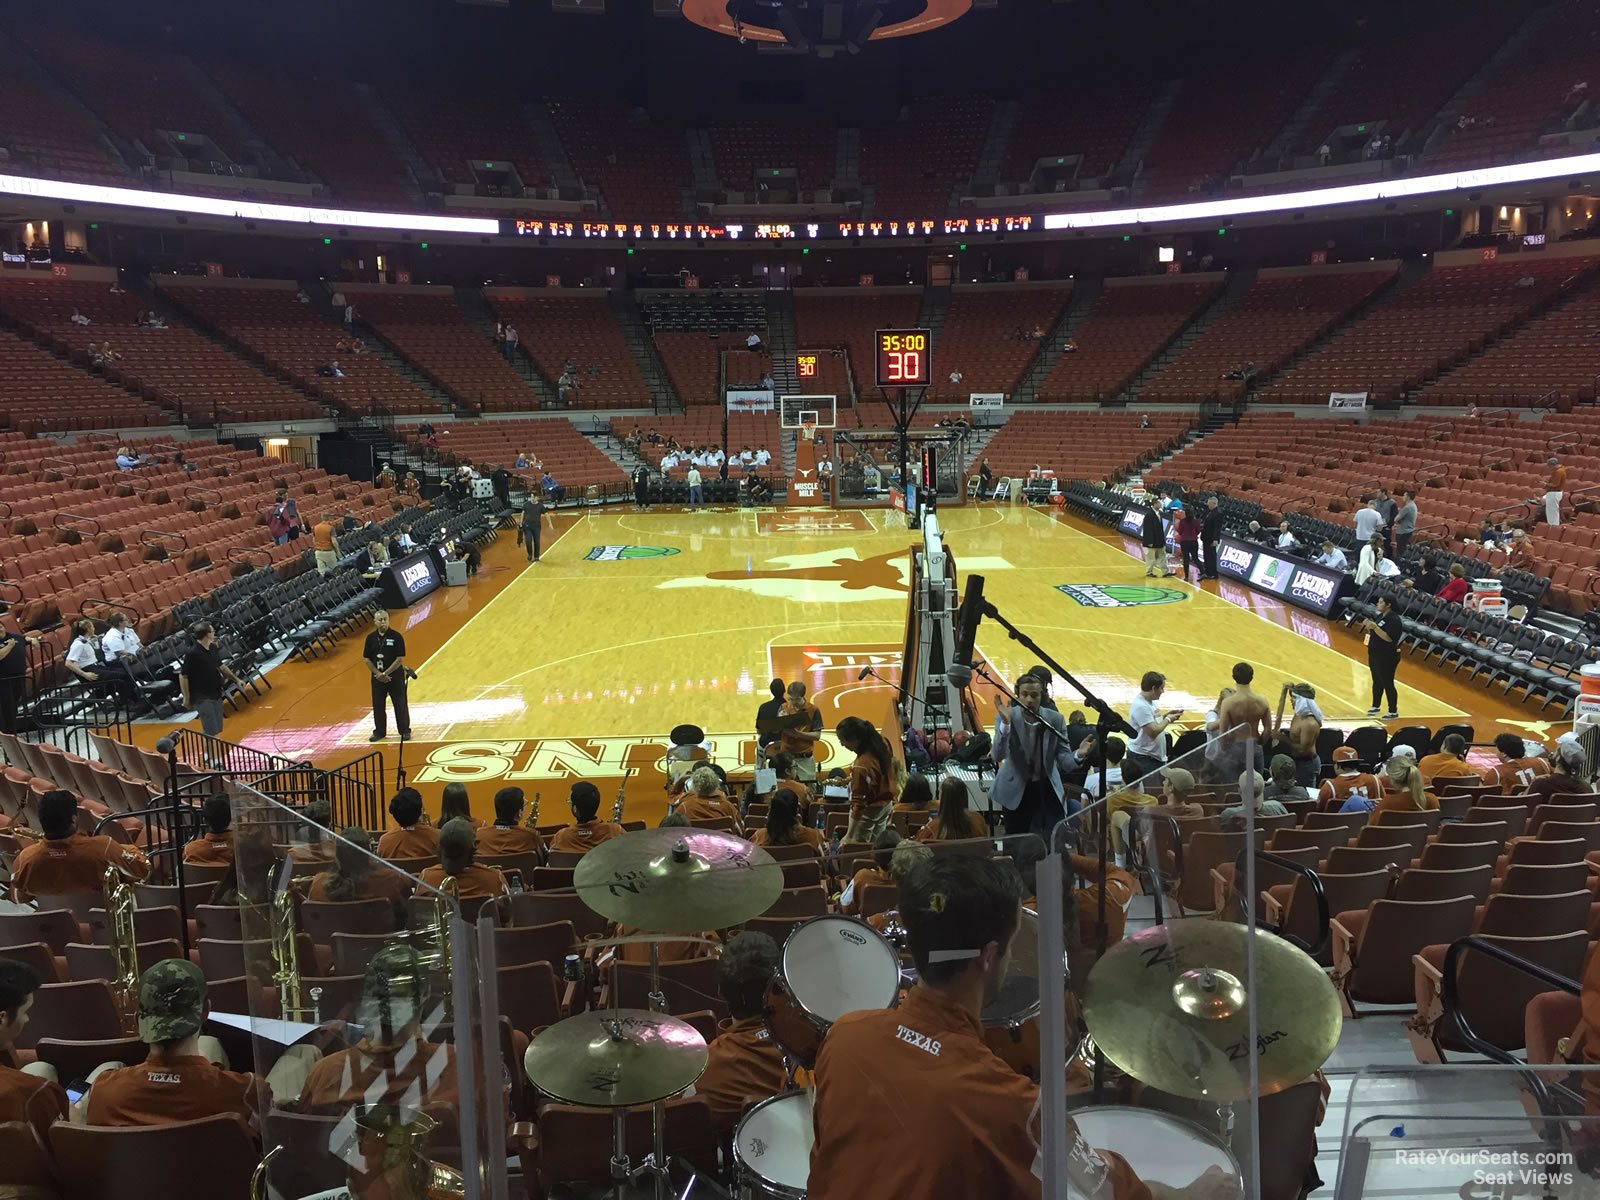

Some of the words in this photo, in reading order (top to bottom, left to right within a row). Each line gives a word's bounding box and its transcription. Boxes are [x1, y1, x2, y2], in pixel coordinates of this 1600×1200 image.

[1483, 249, 1497, 260] 23
[54, 266, 67, 276] 32
[1168, 264, 1180, 273] 25
[882, 335, 925, 351] 35:00
[797, 356, 816, 364] 35:00
[887, 352, 920, 380] 30
[800, 363, 814, 376] 30
[794, 482, 819, 491] MUSCLE
[1220, 545, 1253, 569] LEGENDS
[401, 560, 430, 588] LEGENDS
[1220, 559, 1247, 575] CLASSIC
[411, 576, 432, 593] CLASSIC
[1292, 570, 1335, 599] LEGENDS
[1292, 587, 1328, 606] CLASSIC
[1515, 768, 1537, 785] 11
[147, 1072, 182, 1084] TEXAS
